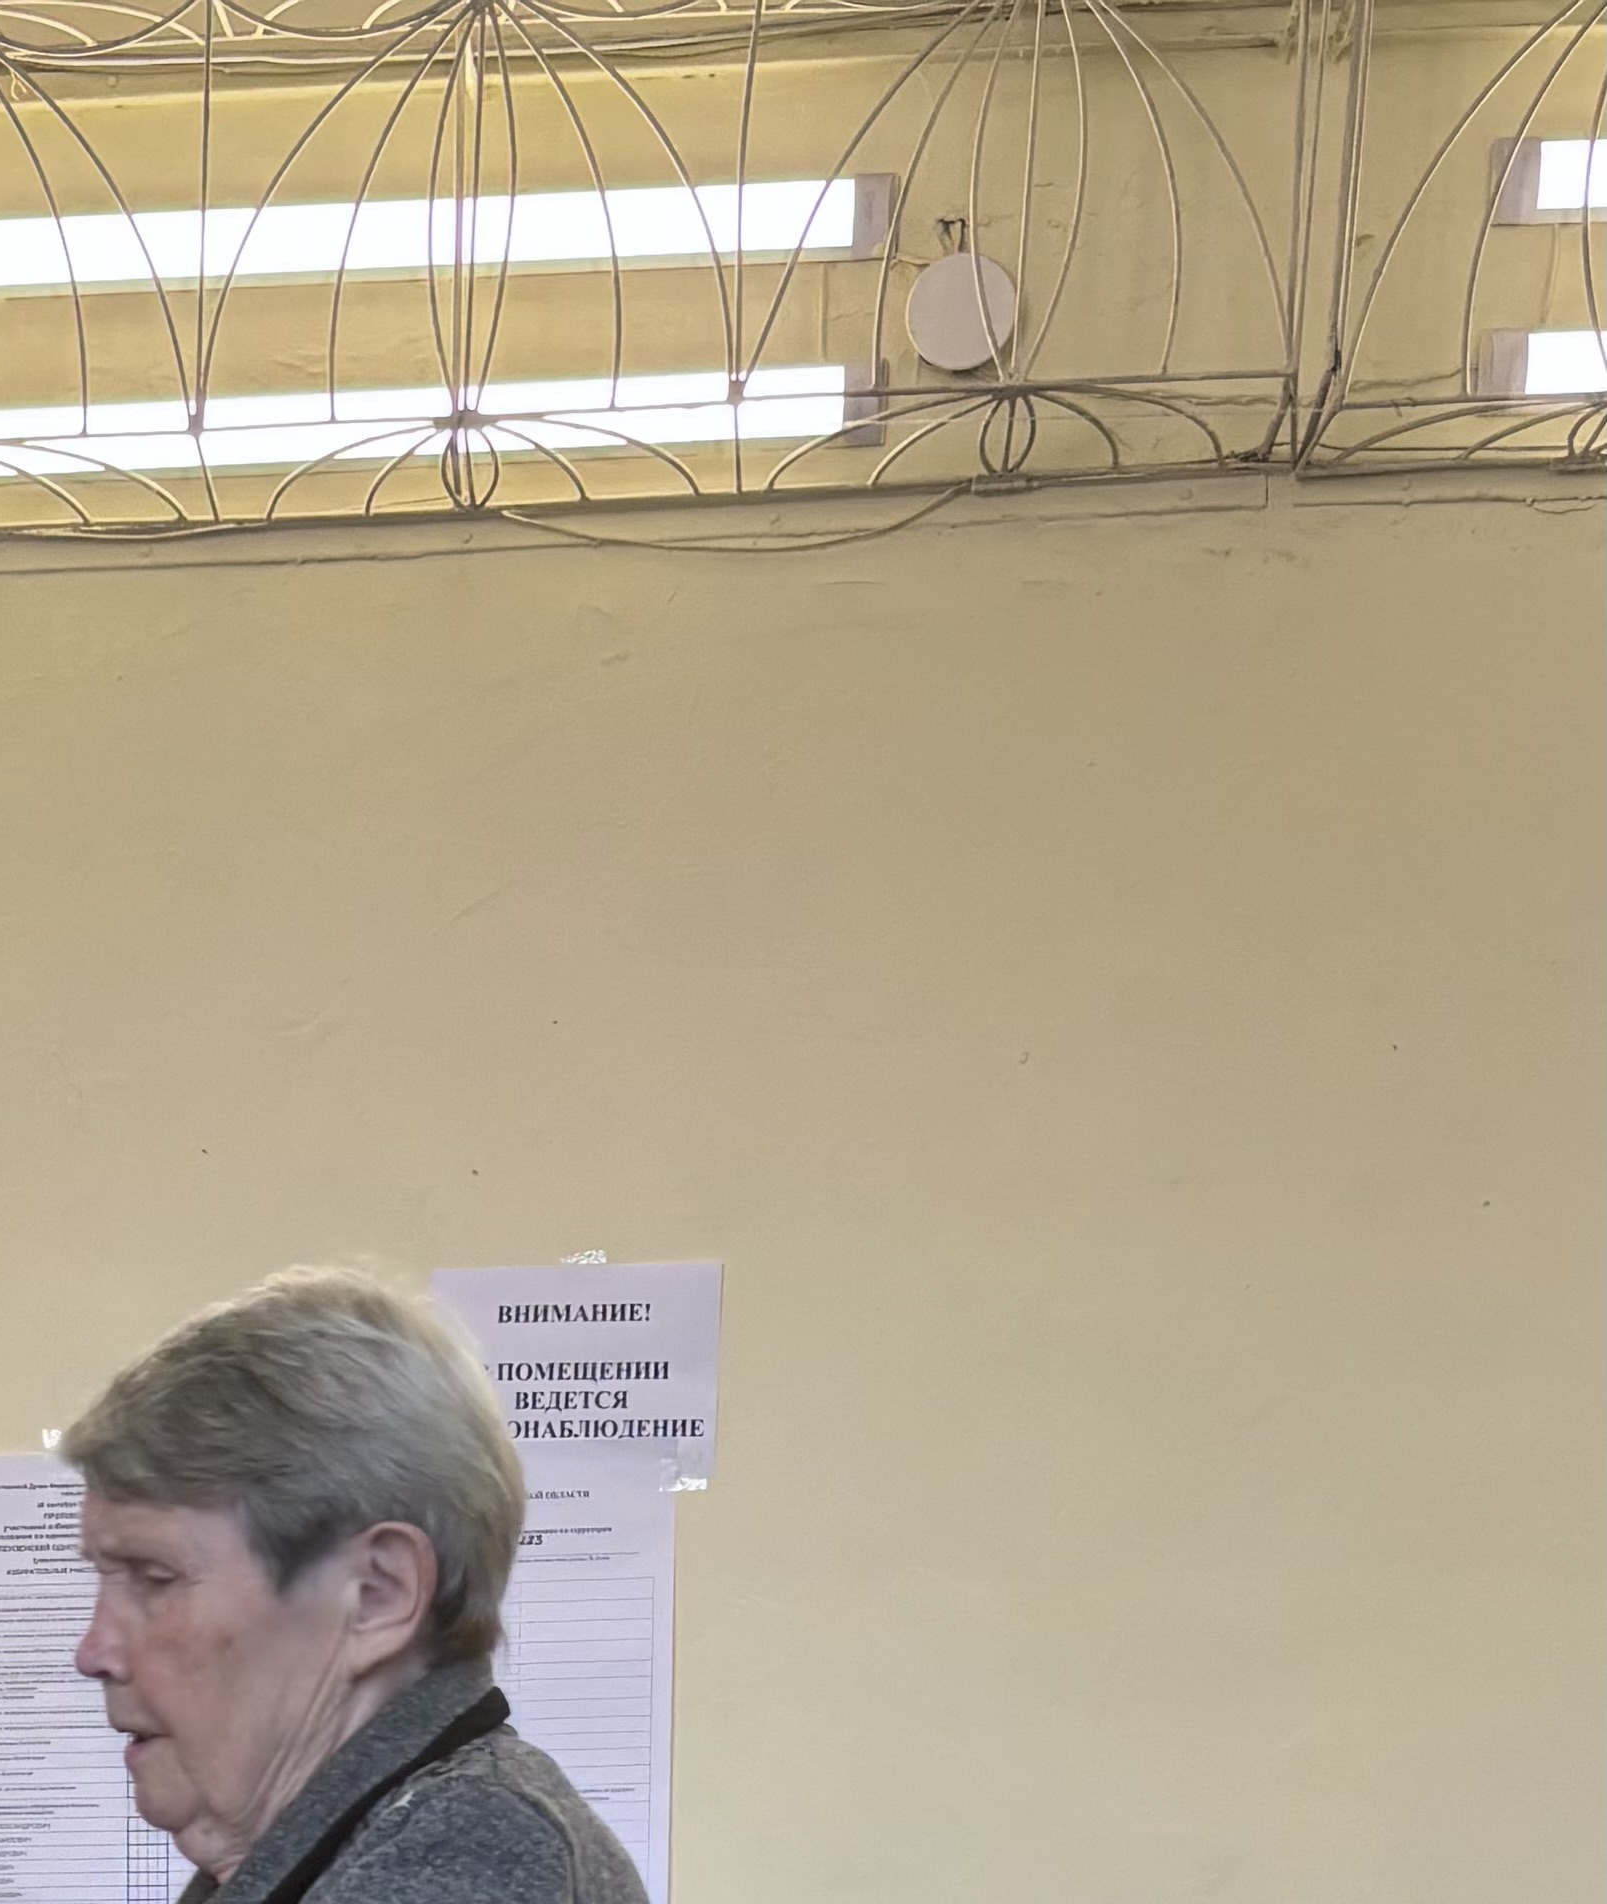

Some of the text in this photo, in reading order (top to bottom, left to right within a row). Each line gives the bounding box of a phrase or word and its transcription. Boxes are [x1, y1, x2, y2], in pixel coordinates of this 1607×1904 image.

[498, 1303, 651, 1323] ВНИМАНИЕ!
[497, 1361, 670, 1383] ПОМЕЩЕНИИ
[515, 1390, 628, 1413] ВЕДЕТСЯ
[507, 1418, 705, 1440] ОНАБЛЮДЕНИЕ
